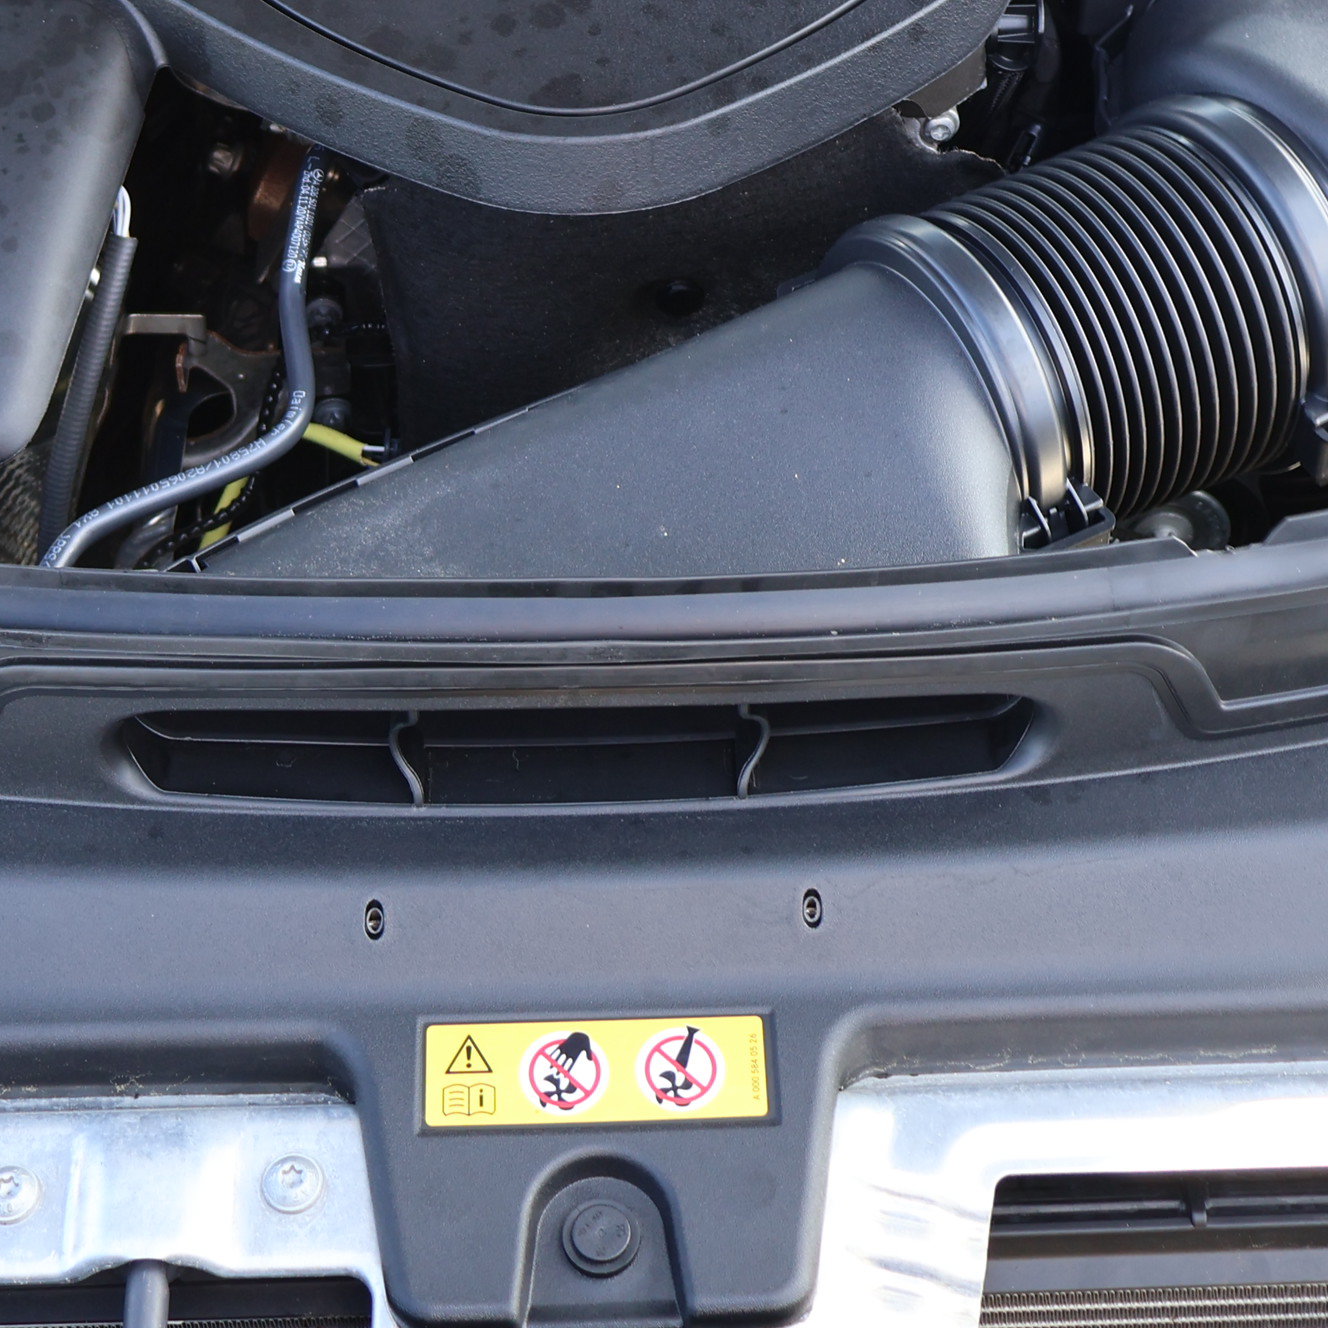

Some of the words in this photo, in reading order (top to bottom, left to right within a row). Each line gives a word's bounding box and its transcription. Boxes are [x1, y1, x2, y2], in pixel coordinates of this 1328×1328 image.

[748, 1033, 757, 1044] 26
[749, 1045, 758, 1057] 05
[751, 1058, 759, 1074] 584
[752, 1076, 760, 1092] 000
